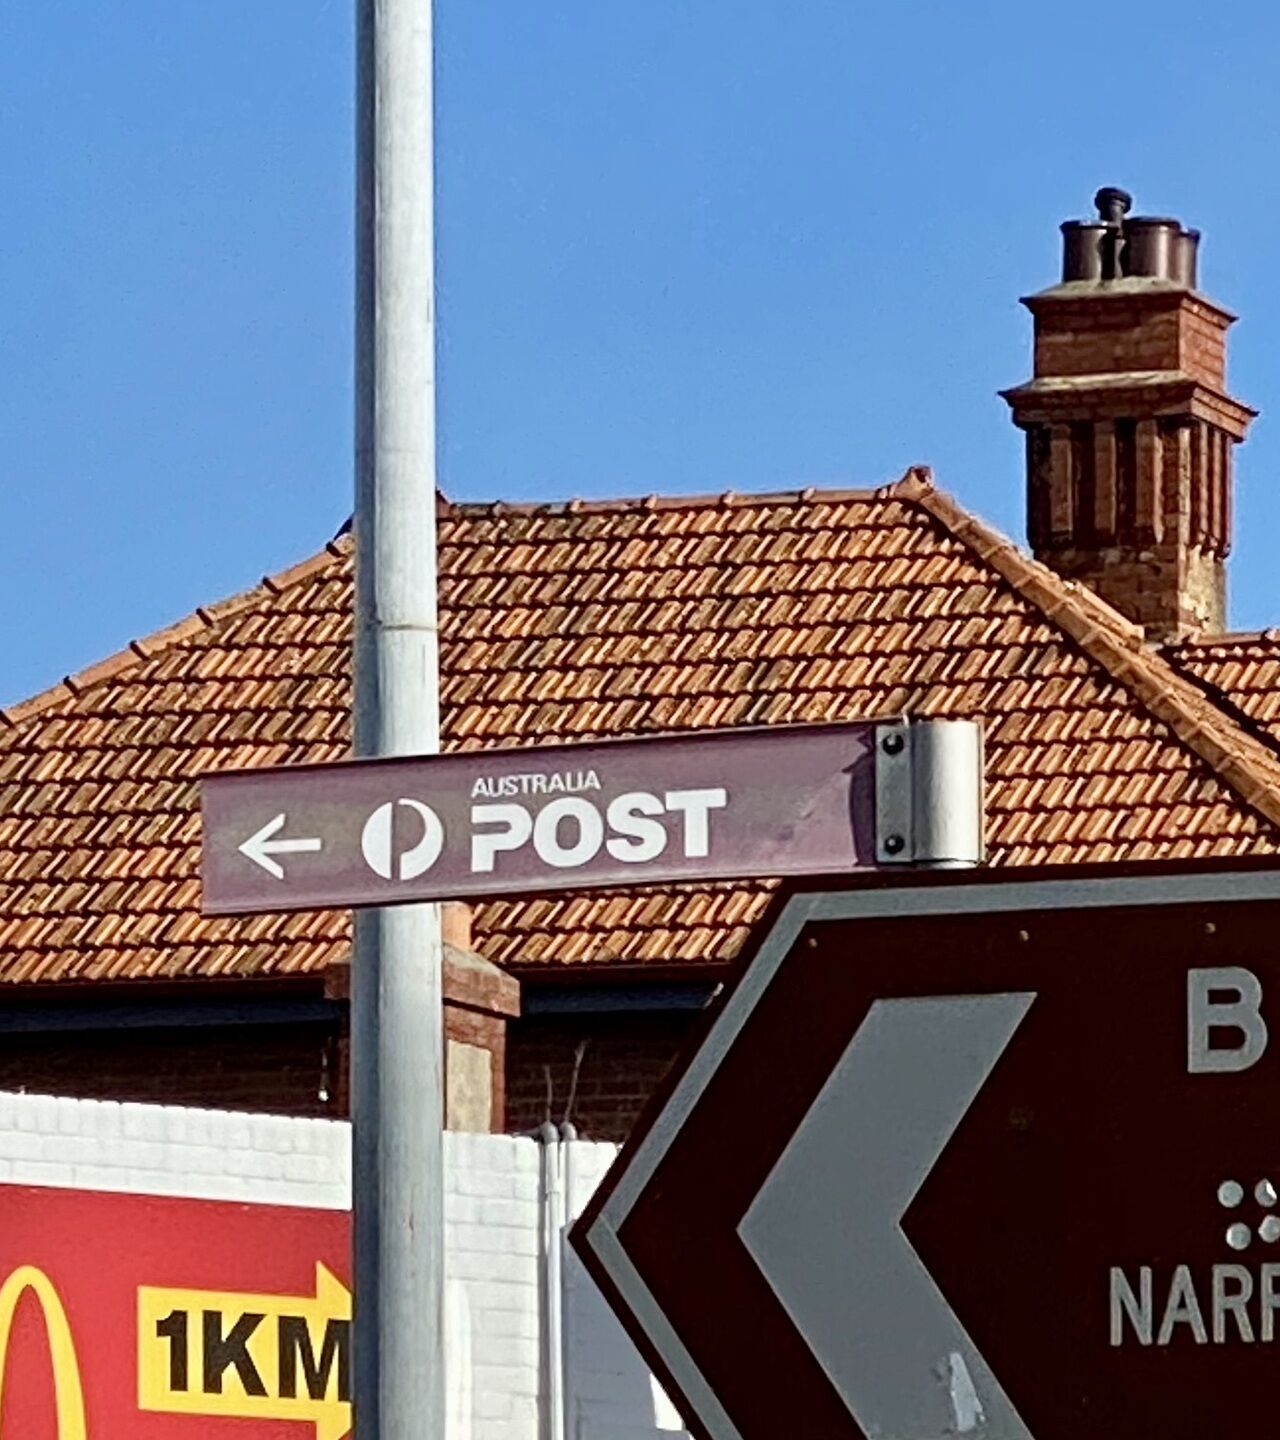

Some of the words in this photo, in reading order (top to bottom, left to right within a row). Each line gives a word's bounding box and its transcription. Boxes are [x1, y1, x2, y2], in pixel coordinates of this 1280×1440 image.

[471, 770, 602, 796] AUSTRALIA
[471, 788, 728, 874] POST
[156, 1309, 350, 1402] 1KM
